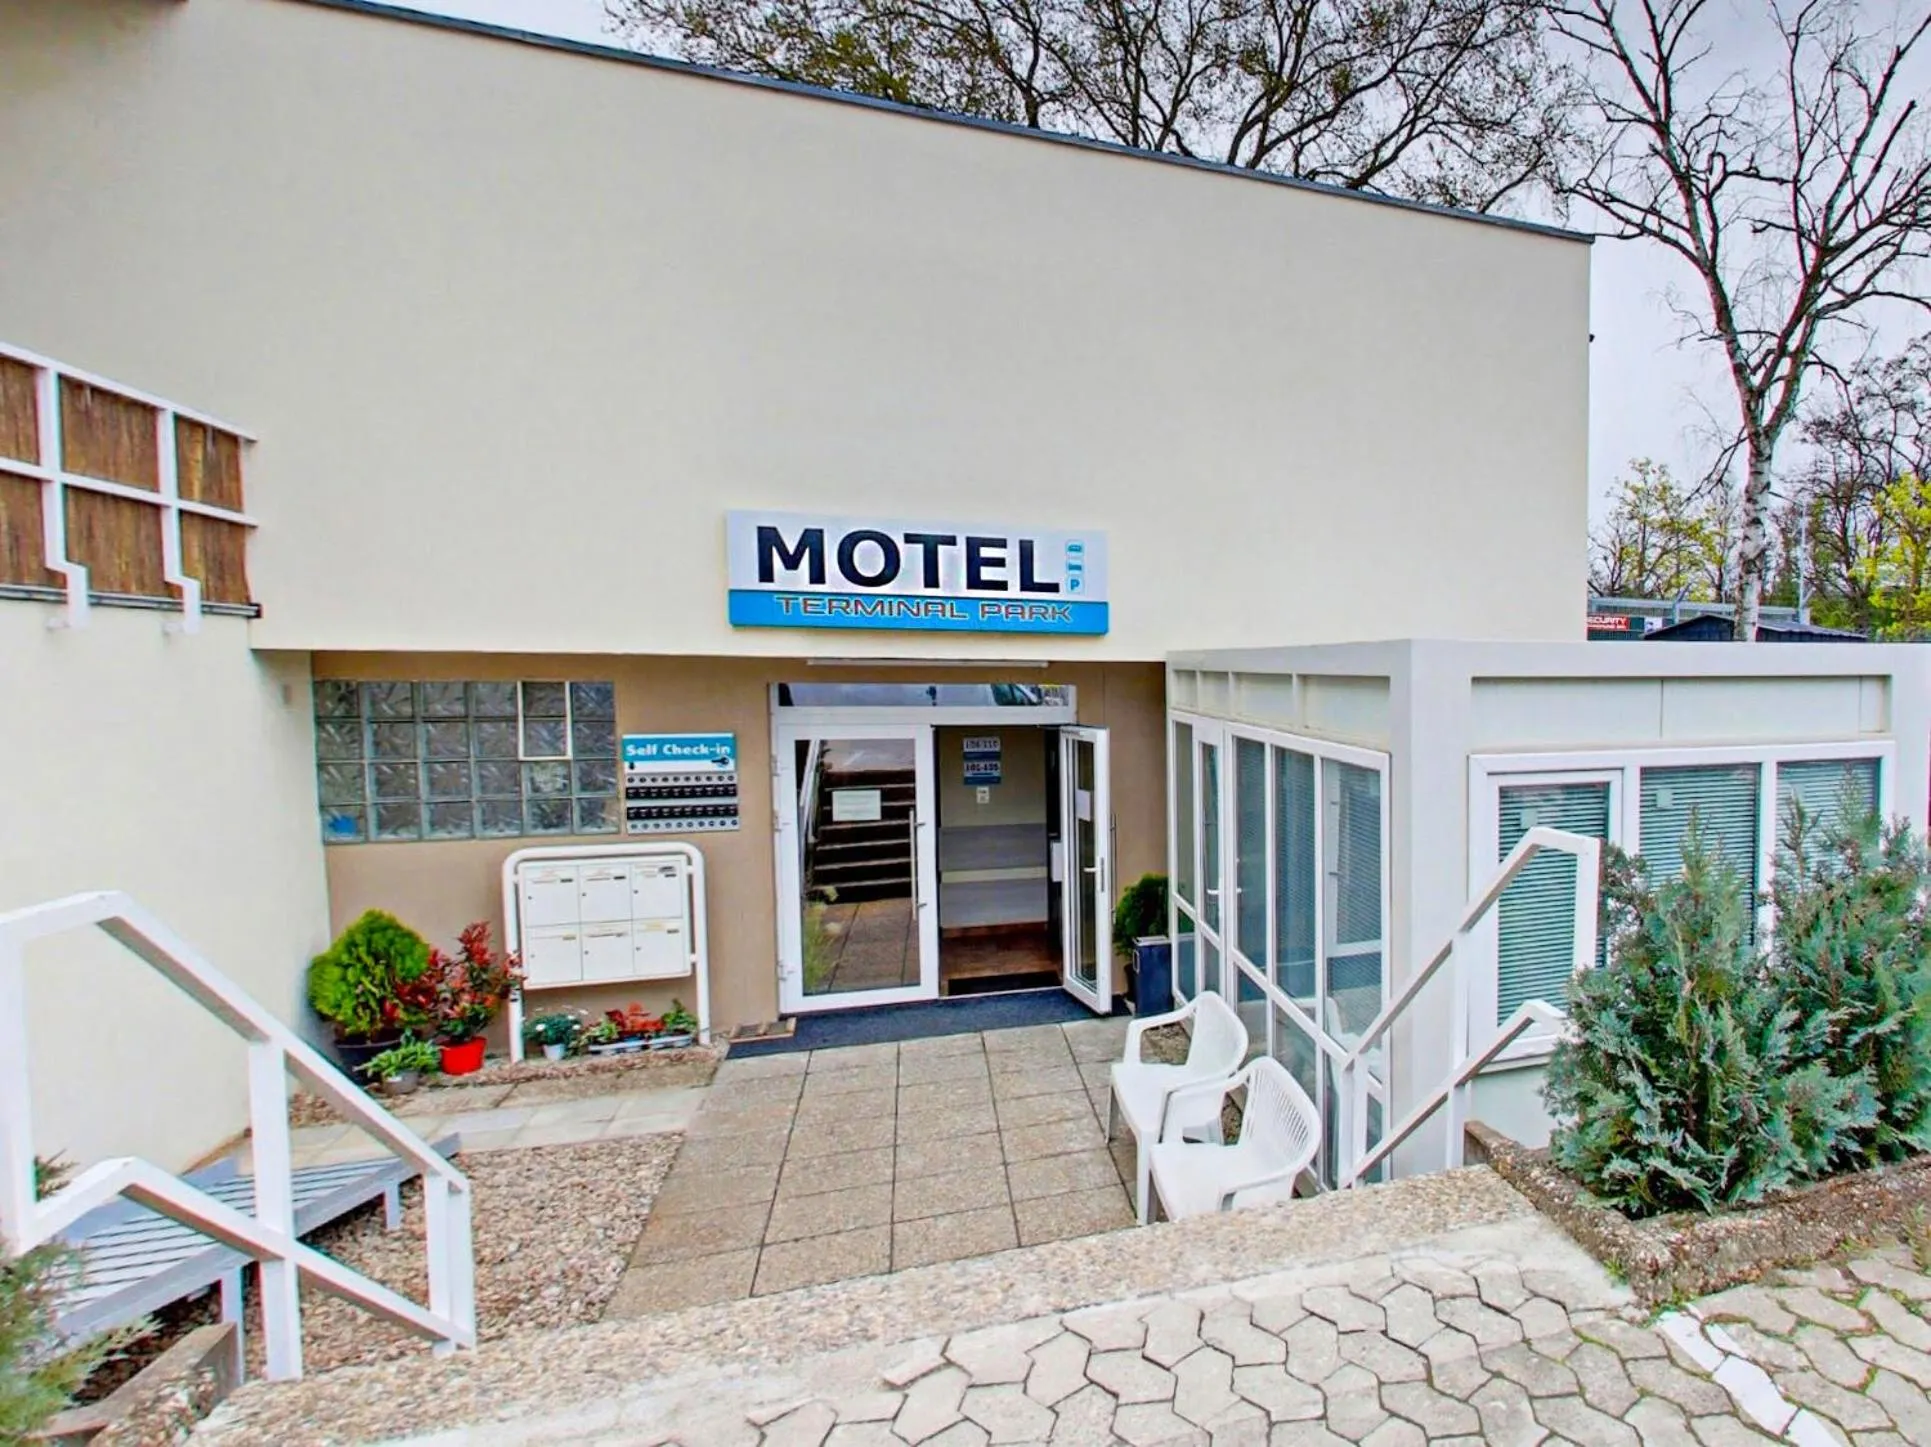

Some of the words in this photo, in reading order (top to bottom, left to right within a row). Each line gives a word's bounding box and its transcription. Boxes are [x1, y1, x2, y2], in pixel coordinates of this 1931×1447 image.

[756, 526, 1060, 593] MOTEL
[775, 594, 968, 620] TERMINAL
[979, 601, 1073, 623] PARK
[626, 744, 657, 756] Self
[662, 742, 731, 756] Check-in
